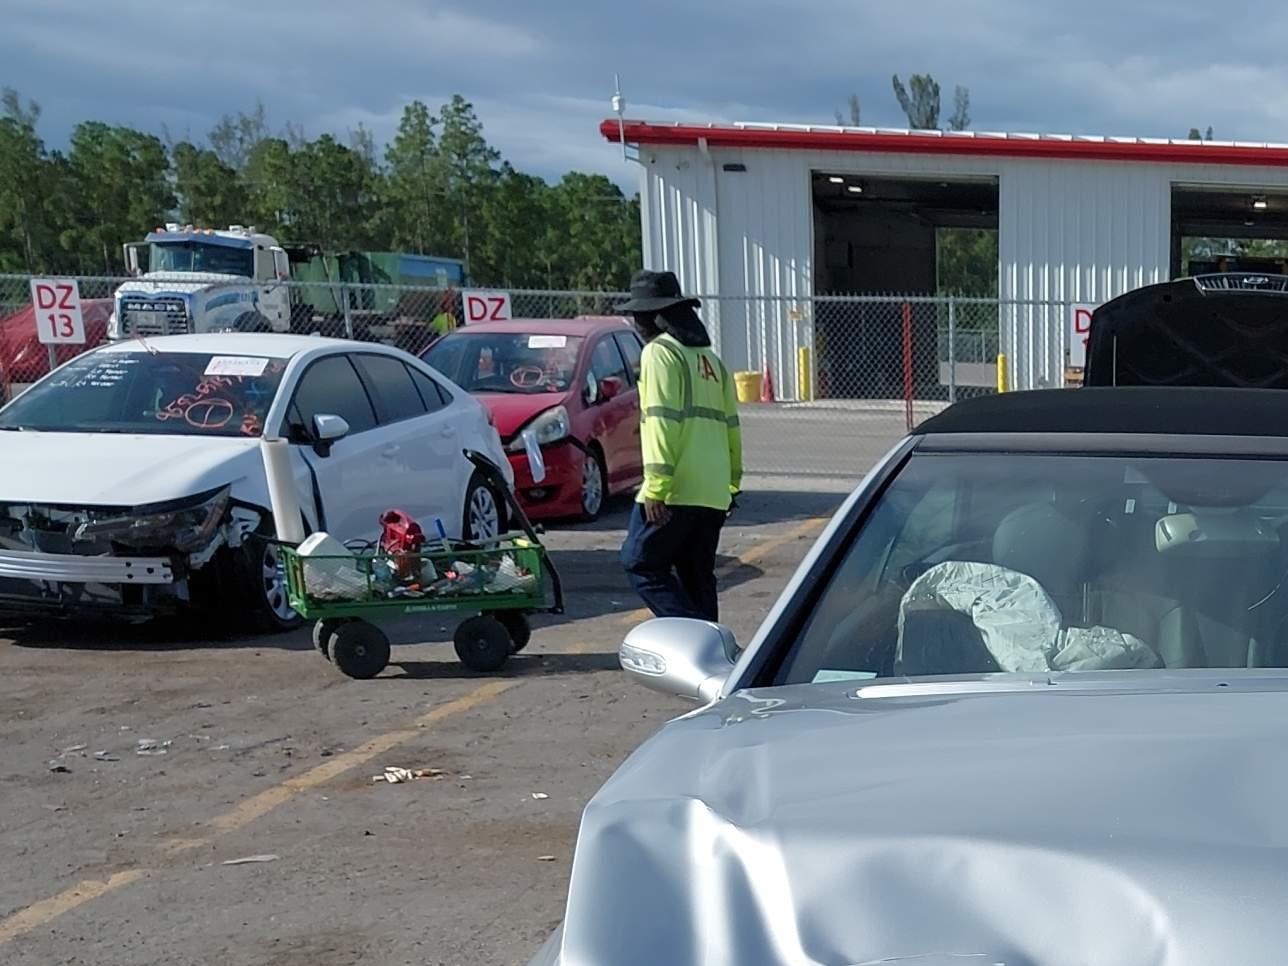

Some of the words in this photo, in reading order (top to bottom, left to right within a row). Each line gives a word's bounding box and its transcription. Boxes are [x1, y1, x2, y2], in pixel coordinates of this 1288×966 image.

[36, 285, 76, 310] DZ
[127, 303, 180, 311] MACK
[468, 297, 507, 321] DZ
[48, 314, 74, 338] 13
[1075, 309, 1092, 333] D
